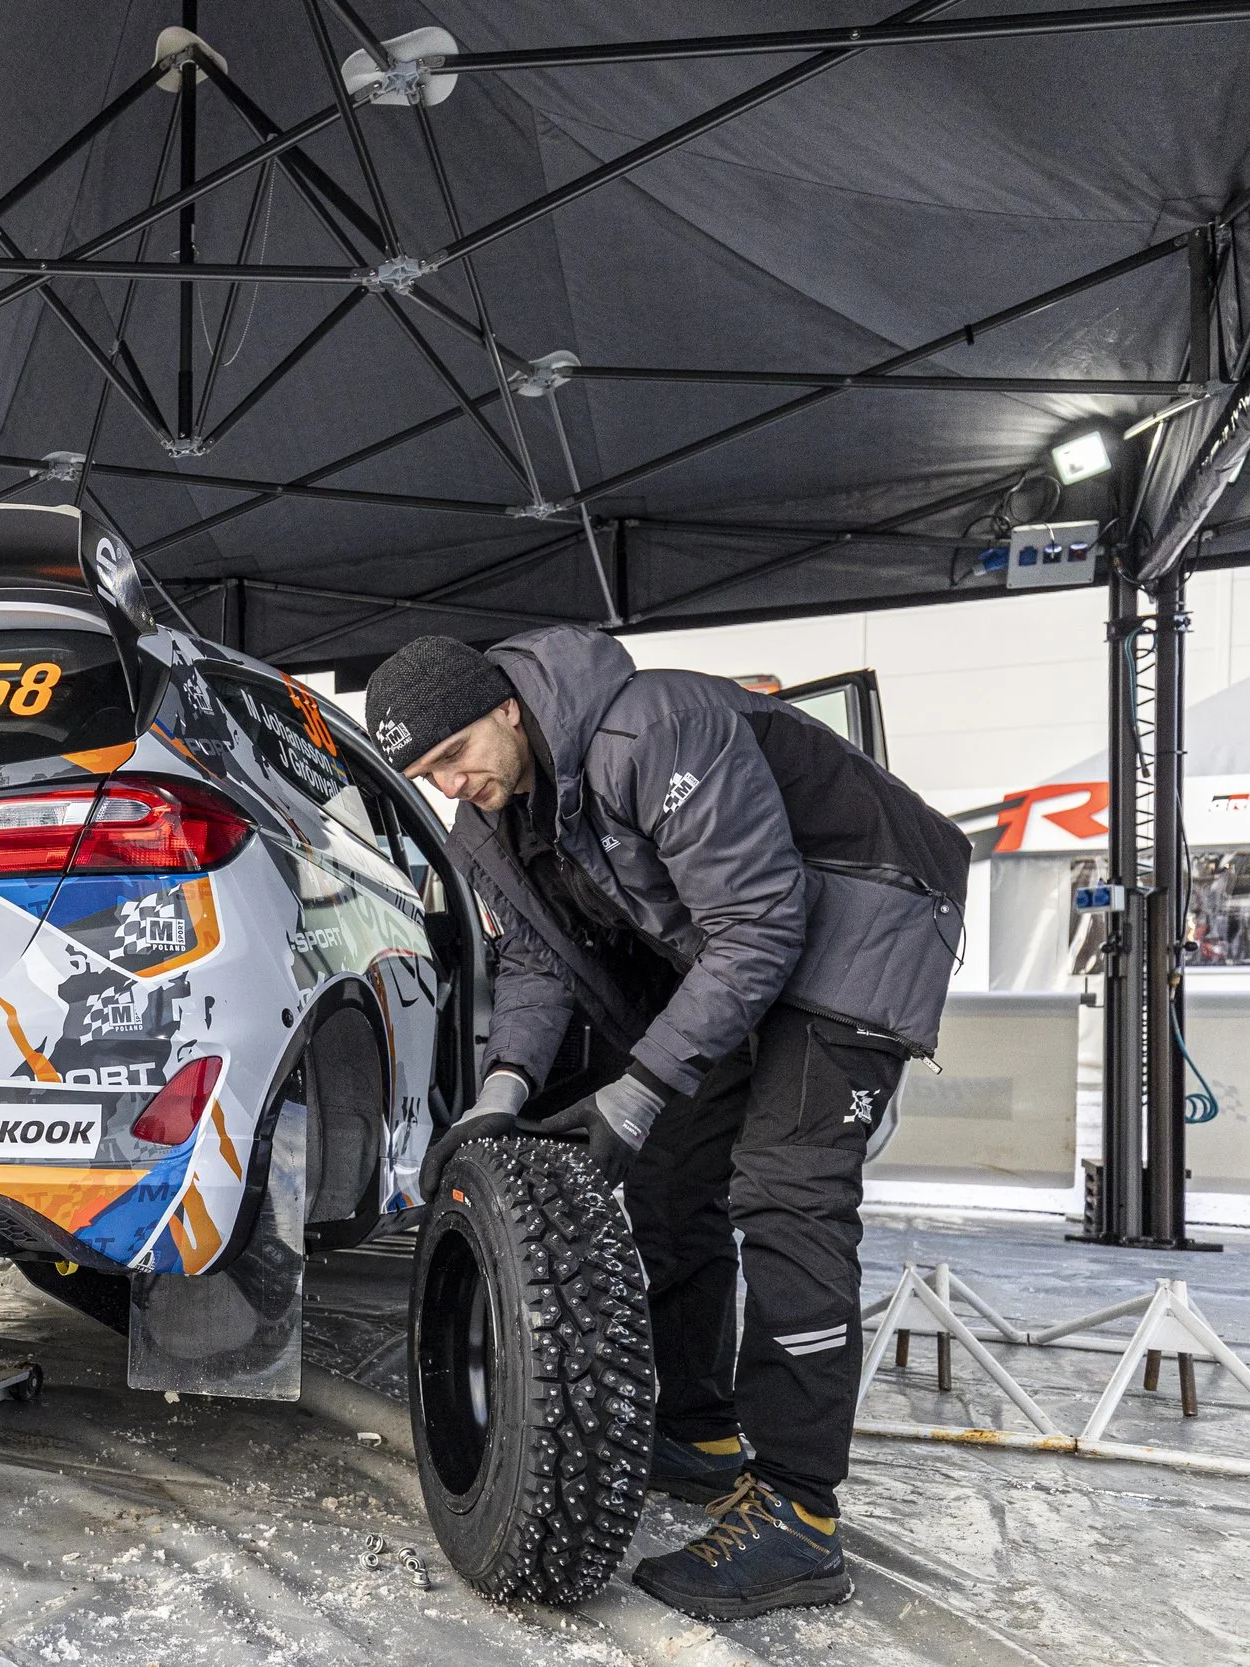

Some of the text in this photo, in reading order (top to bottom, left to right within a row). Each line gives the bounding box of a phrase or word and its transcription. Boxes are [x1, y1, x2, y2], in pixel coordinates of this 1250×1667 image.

[241, 688, 262, 723] M
[261, 703, 334, 776] Johansson
[279, 740, 290, 769] J
[149, 920, 174, 942] M
[152, 944, 187, 952] POLAND
[111, 1006, 133, 1026] M
[115, 1024, 143, 1032] POLAND
